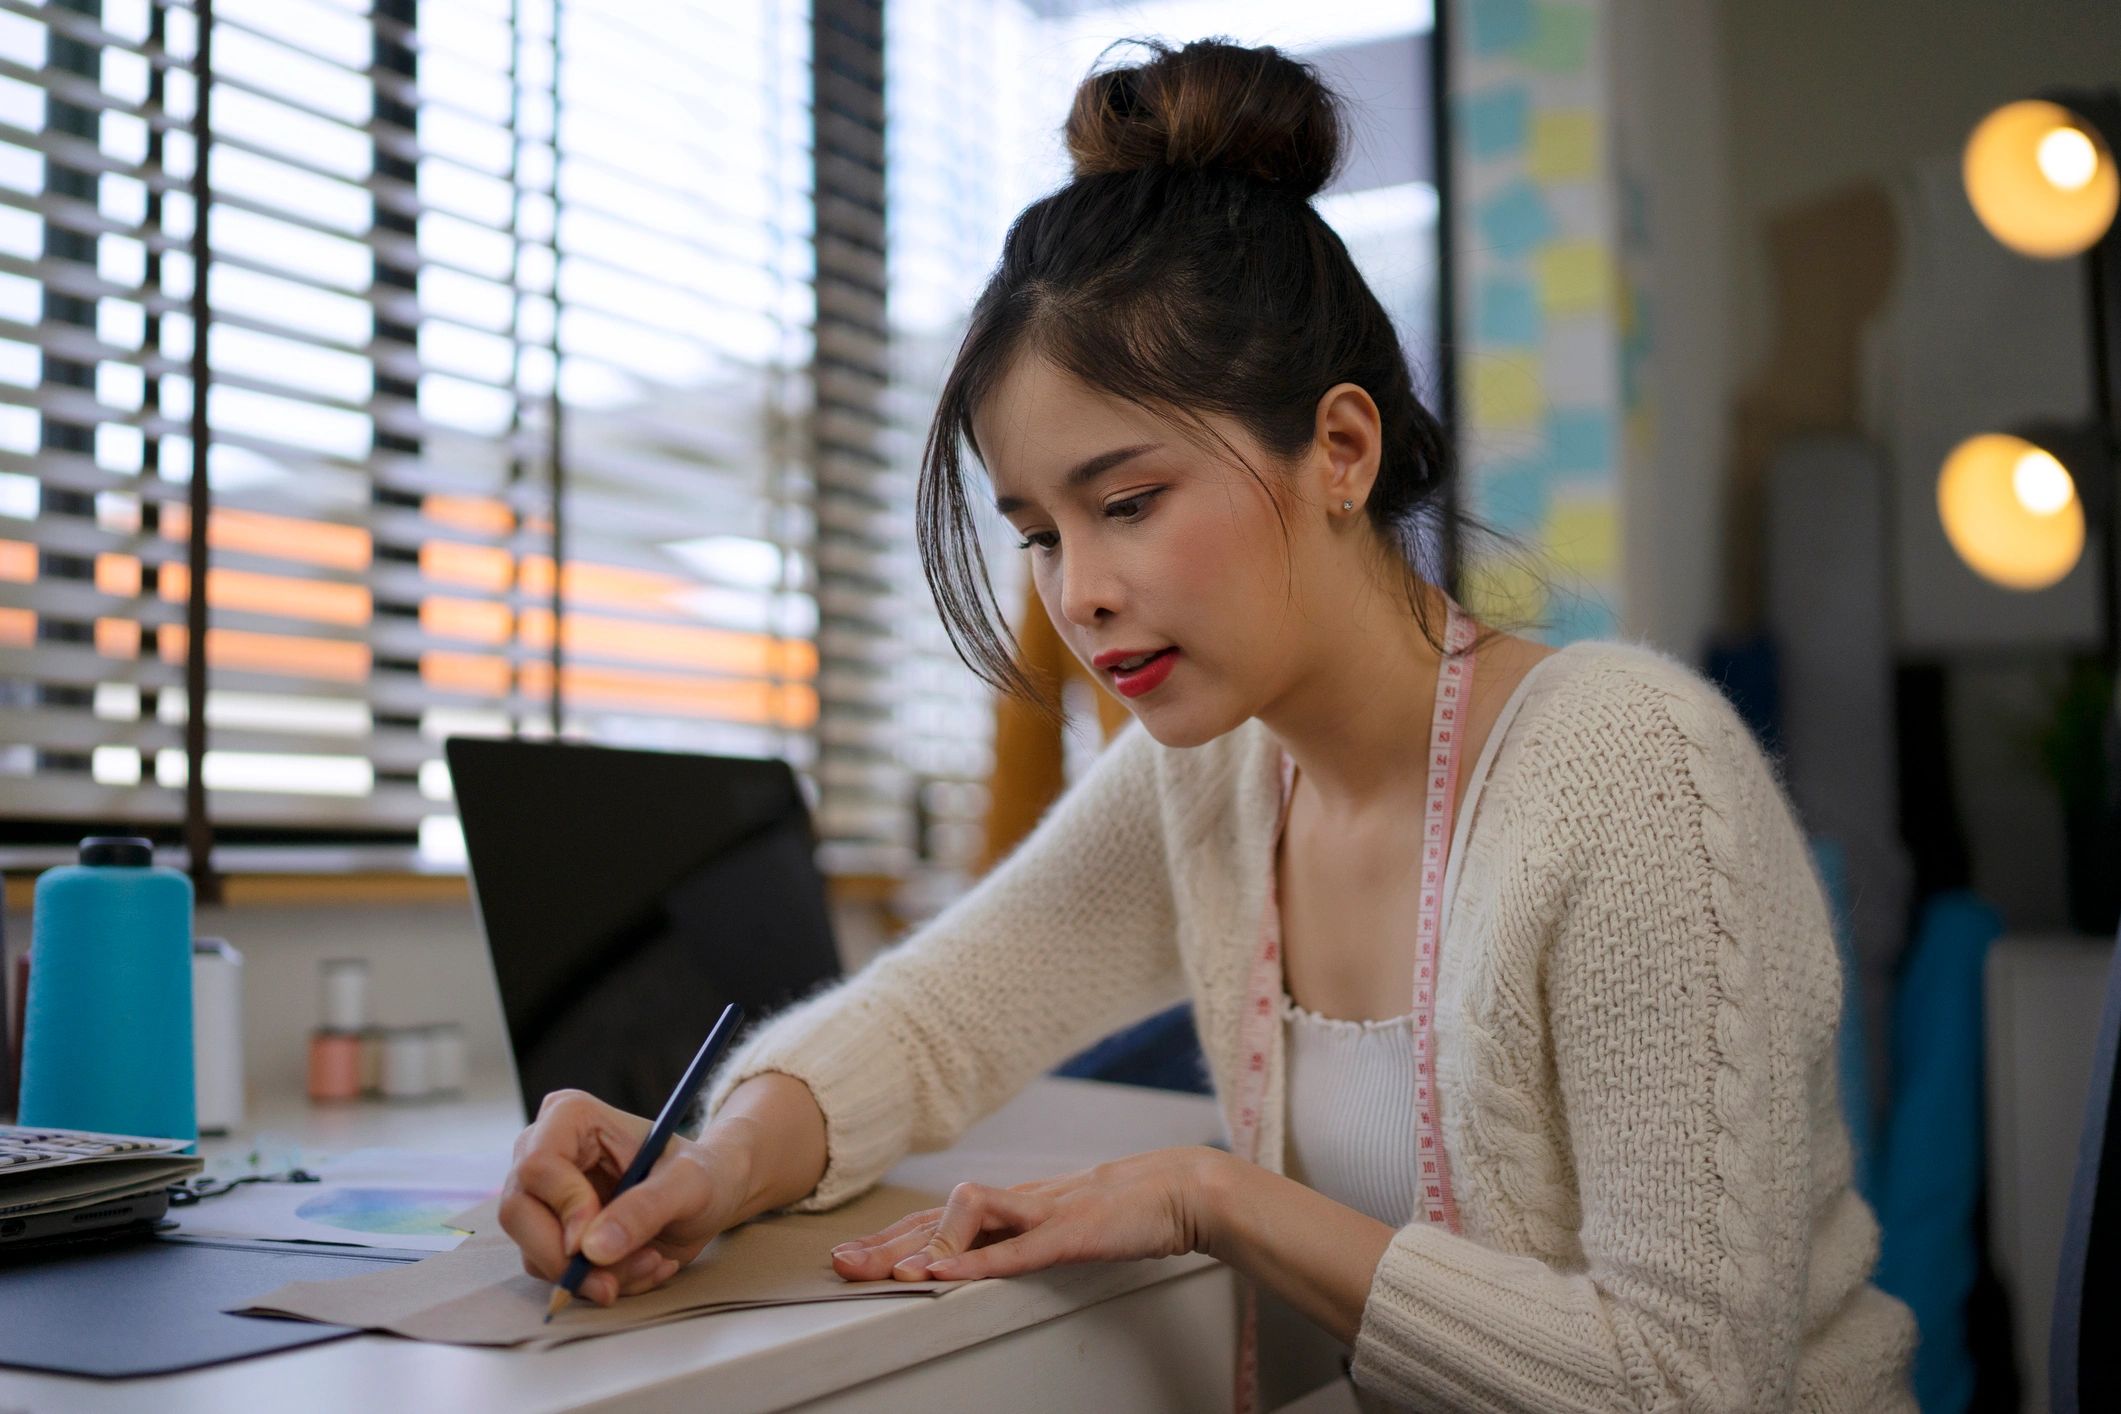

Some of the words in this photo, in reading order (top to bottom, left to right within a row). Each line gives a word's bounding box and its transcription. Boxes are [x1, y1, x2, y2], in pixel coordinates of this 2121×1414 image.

[1444, 685, 1456, 697] 81
[1441, 708, 1454, 720] 82
[1438, 731, 1450, 742] 83
[1436, 754, 1447, 766] 84
[1420, 1136, 1433, 1149] 100
[1423, 1161, 1436, 1173] 101
[1426, 1185, 1440, 1197] 102
